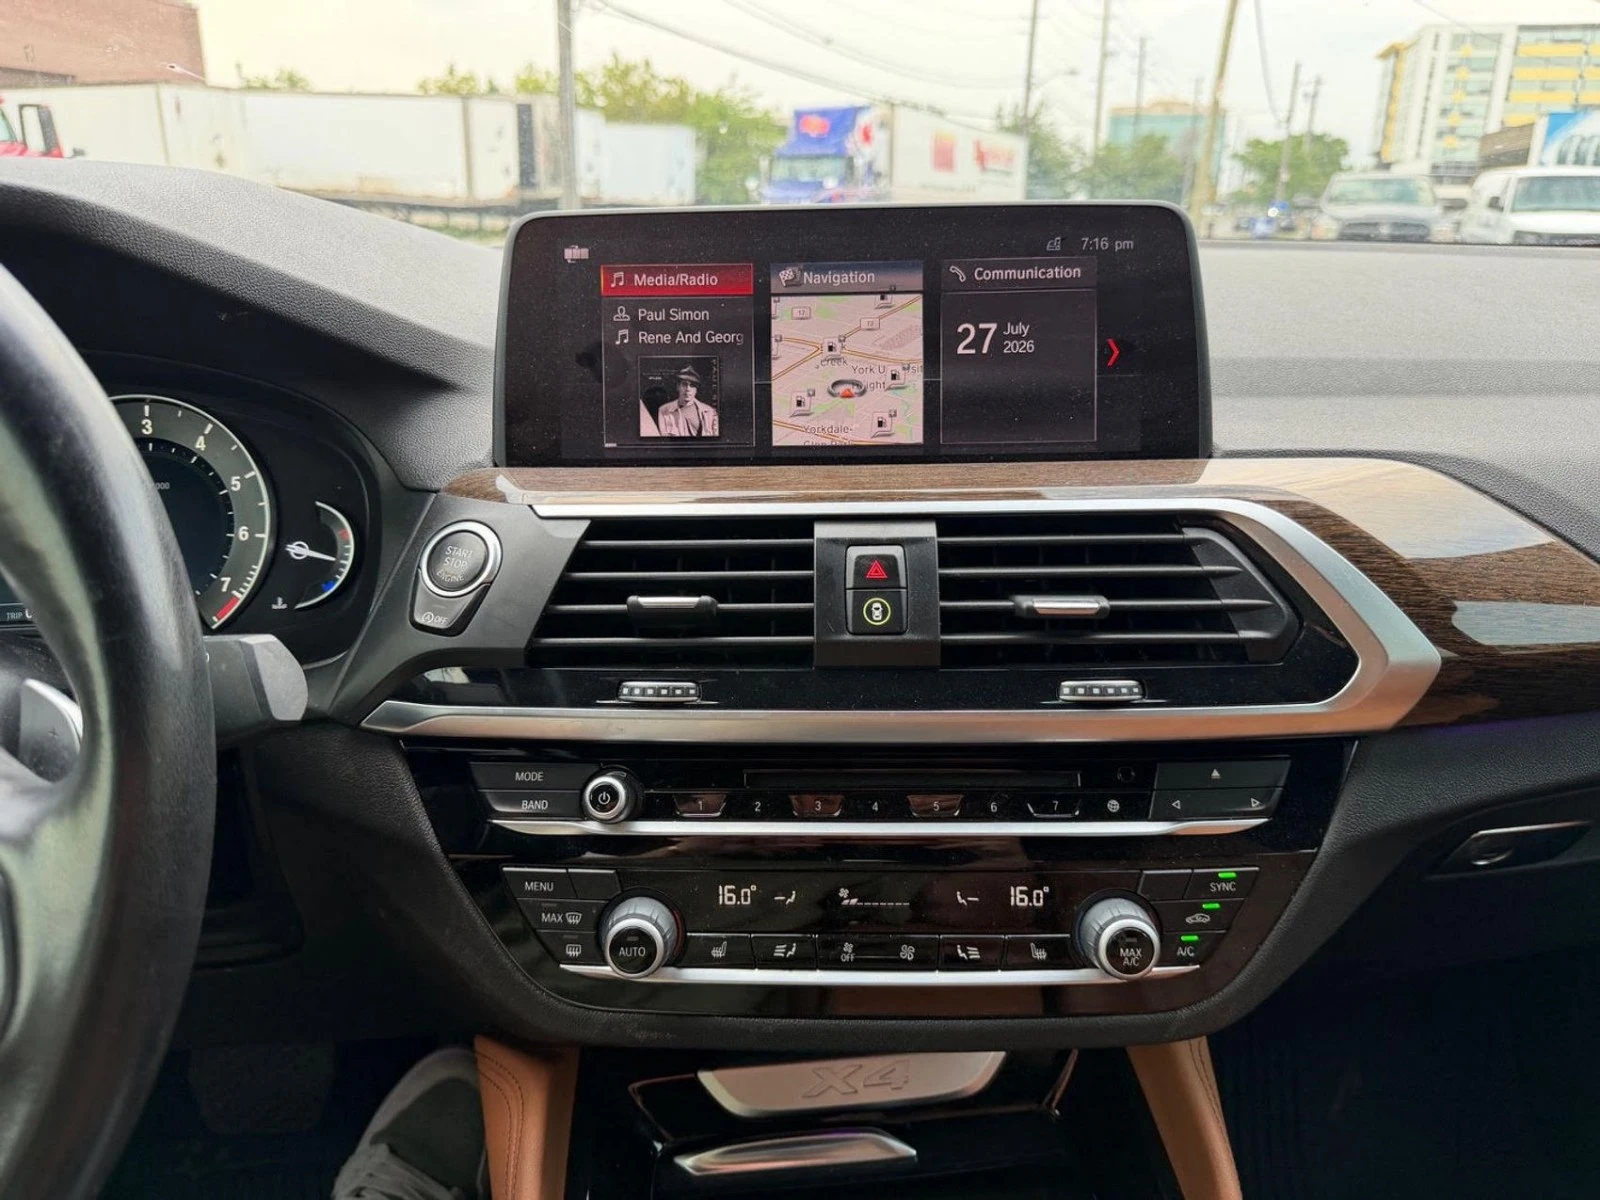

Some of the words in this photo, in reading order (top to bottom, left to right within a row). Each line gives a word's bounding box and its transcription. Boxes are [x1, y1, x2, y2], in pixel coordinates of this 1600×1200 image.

[1081, 237, 1109, 250] 7:16
[1114, 240, 1134, 252] pm
[633, 272, 718, 287] Media/Radio
[803, 270, 876, 286] Navigation
[974, 266, 1081, 281] Communication
[638, 308, 666, 321] Paul
[669, 308, 710, 321] Simon
[1003, 321, 1030, 337] July
[638, 331, 672, 344] Rene
[675, 331, 701, 344] And
[705, 331, 744, 345] Georg
[956, 322, 998, 355] 27
[1003, 340, 1035, 353] 2026
[851, 365, 875, 375] York
[141, 419, 153, 435] 3
[194, 435, 206, 451] 4
[230, 476, 241, 491] 5
[238, 526, 249, 541] 6
[445, 545, 473, 558] START
[443, 556, 468, 569] STOP
[220, 577, 232, 592] 7
[433, 615, 448, 625] OFF
[515, 771, 544, 782] MODE
[521, 800, 549, 811] BAND
[754, 801, 761, 812] 2
[814, 801, 822, 811] 3
[871, 801, 879, 812] 4
[932, 801, 940, 812] 5
[990, 801, 998, 812] 6
[1052, 801, 1059, 812] 7
[524, 881, 554, 891] MENU
[1209, 882, 1237, 893] SYNC
[541, 912, 563, 923] MAX
[618, 946, 646, 957] AUTO
[840, 953, 856, 962] OFF
[1119, 948, 1142, 958] MAX
[1176, 945, 1195, 957] A/C
[1122, 957, 1140, 967] A/C
[802, 1059, 909, 1099] X4
